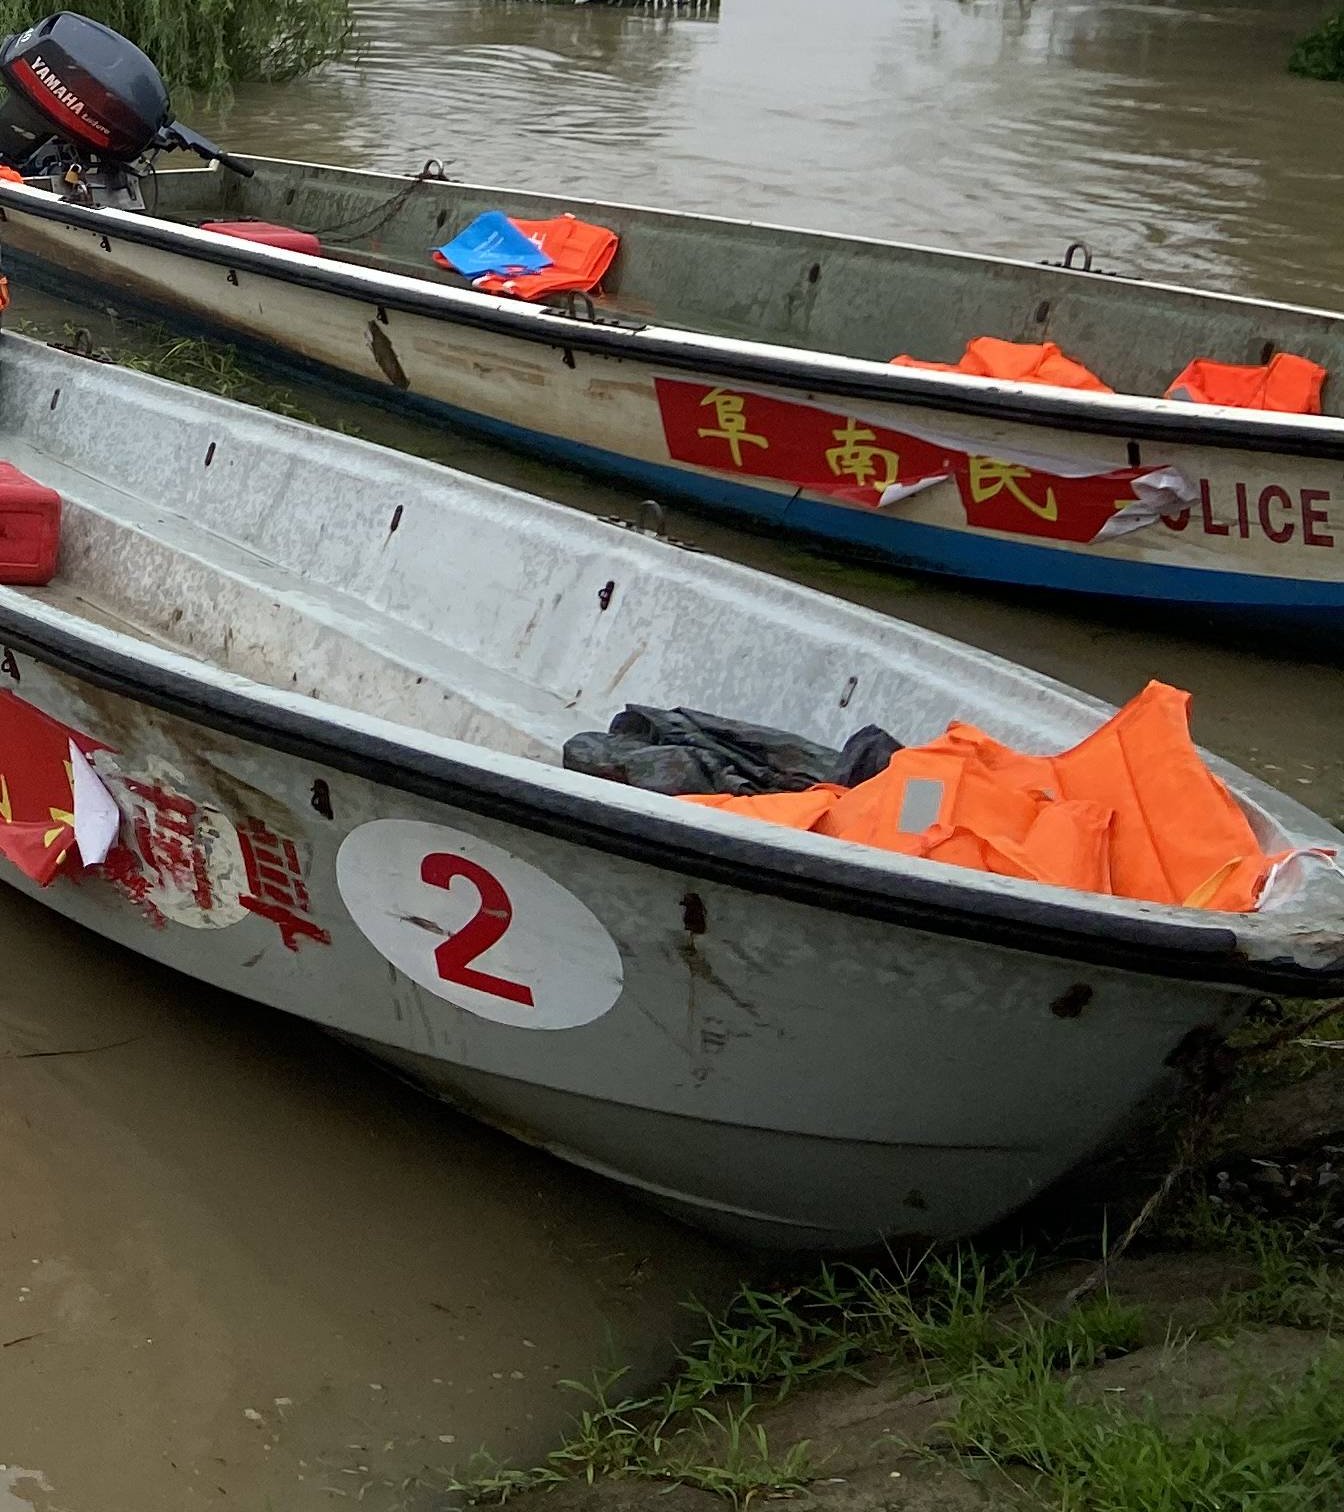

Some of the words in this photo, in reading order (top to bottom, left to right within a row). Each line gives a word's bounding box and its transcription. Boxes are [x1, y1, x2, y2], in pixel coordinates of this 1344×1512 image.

[31, 55, 85, 116] YAMAHA
[696, 387, 1134, 522] 阜南民
[420, 851, 535, 1007] 2
